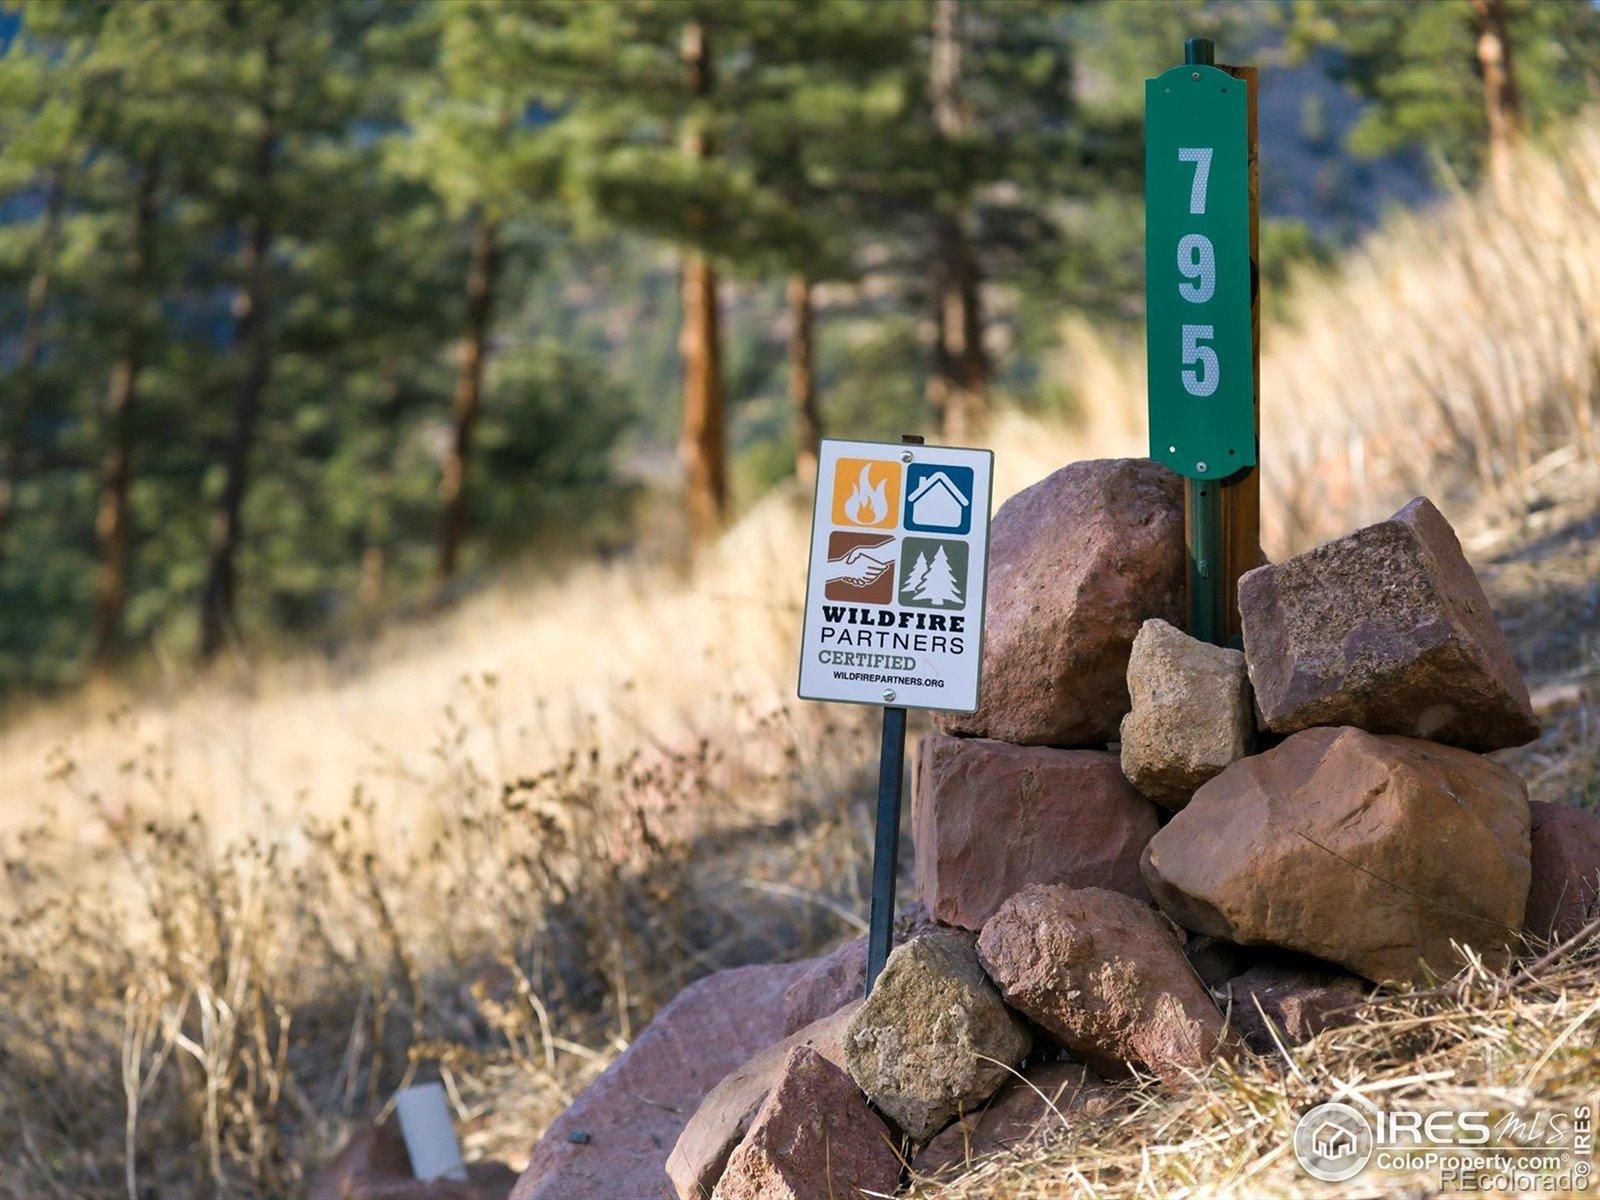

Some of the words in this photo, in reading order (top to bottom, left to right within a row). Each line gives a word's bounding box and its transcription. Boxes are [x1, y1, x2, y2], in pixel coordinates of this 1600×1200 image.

[1177, 147, 1220, 398] 795
[822, 605, 965, 633] WILDFIRE
[820, 627, 965, 655] PARTNERS
[818, 650, 917, 671] CERTIFIED
[833, 671, 944, 688] WILDFIREPARTNERS.ORG
